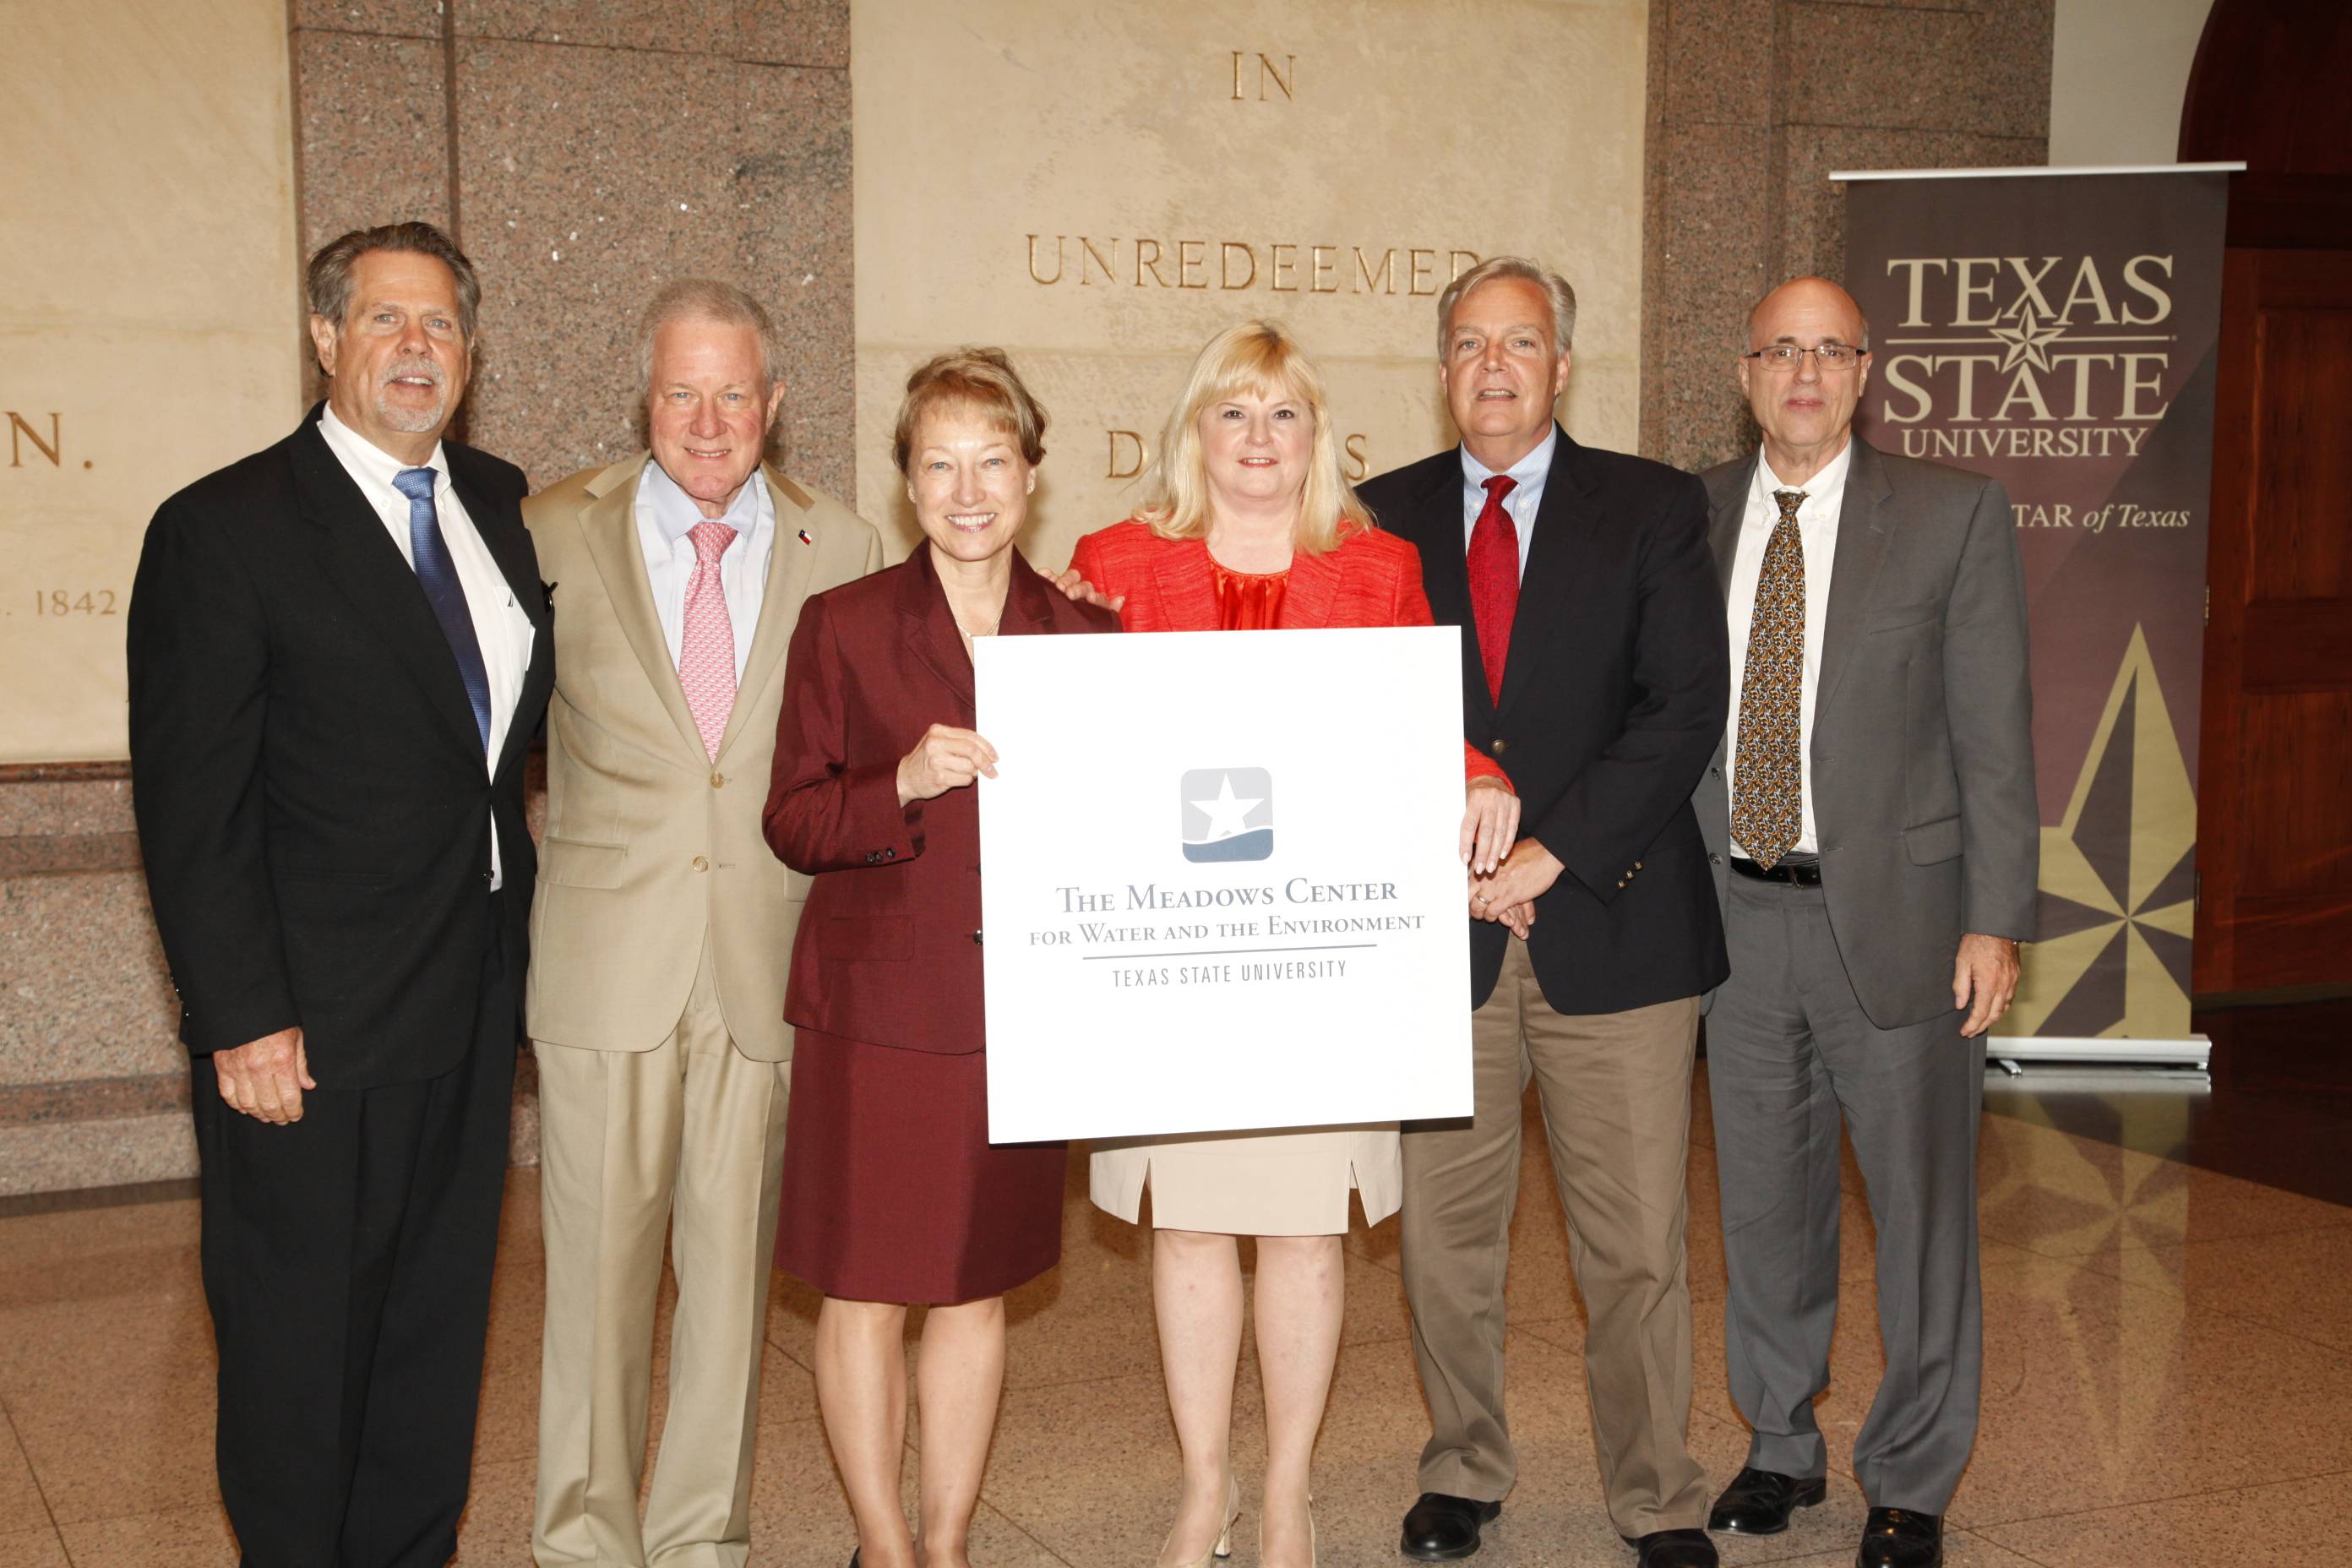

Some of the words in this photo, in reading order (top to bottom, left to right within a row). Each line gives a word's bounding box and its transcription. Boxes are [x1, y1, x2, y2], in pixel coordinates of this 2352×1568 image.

[1230, 51, 1297, 102] IN
[1887, 254, 2174, 328] TEXAS
[1884, 353, 2170, 423] STATE
[1902, 427, 2149, 459] UNIVERSITY
[2011, 504, 2075, 528] TAR
[2082, 504, 2115, 534] of
[2118, 504, 2191, 528] Texas
[35, 589, 117, 617] 1842
[1055, 886, 1116, 913] THE
[1126, 884, 1275, 911] MEADOWS
[1285, 877, 1398, 904] CENTER
[1029, 931, 1073, 946] FOR
[1077, 923, 1157, 944] WATER
[1164, 924, 1209, 940] AND
[1216, 922, 1260, 938] THE
[1268, 915, 1425, 936] ENVIRONMENT
[1113, 968, 1169, 988] TEXAS
[1180, 965, 1231, 984] STATE
[1242, 960, 1347, 982] UNIVERSITY
